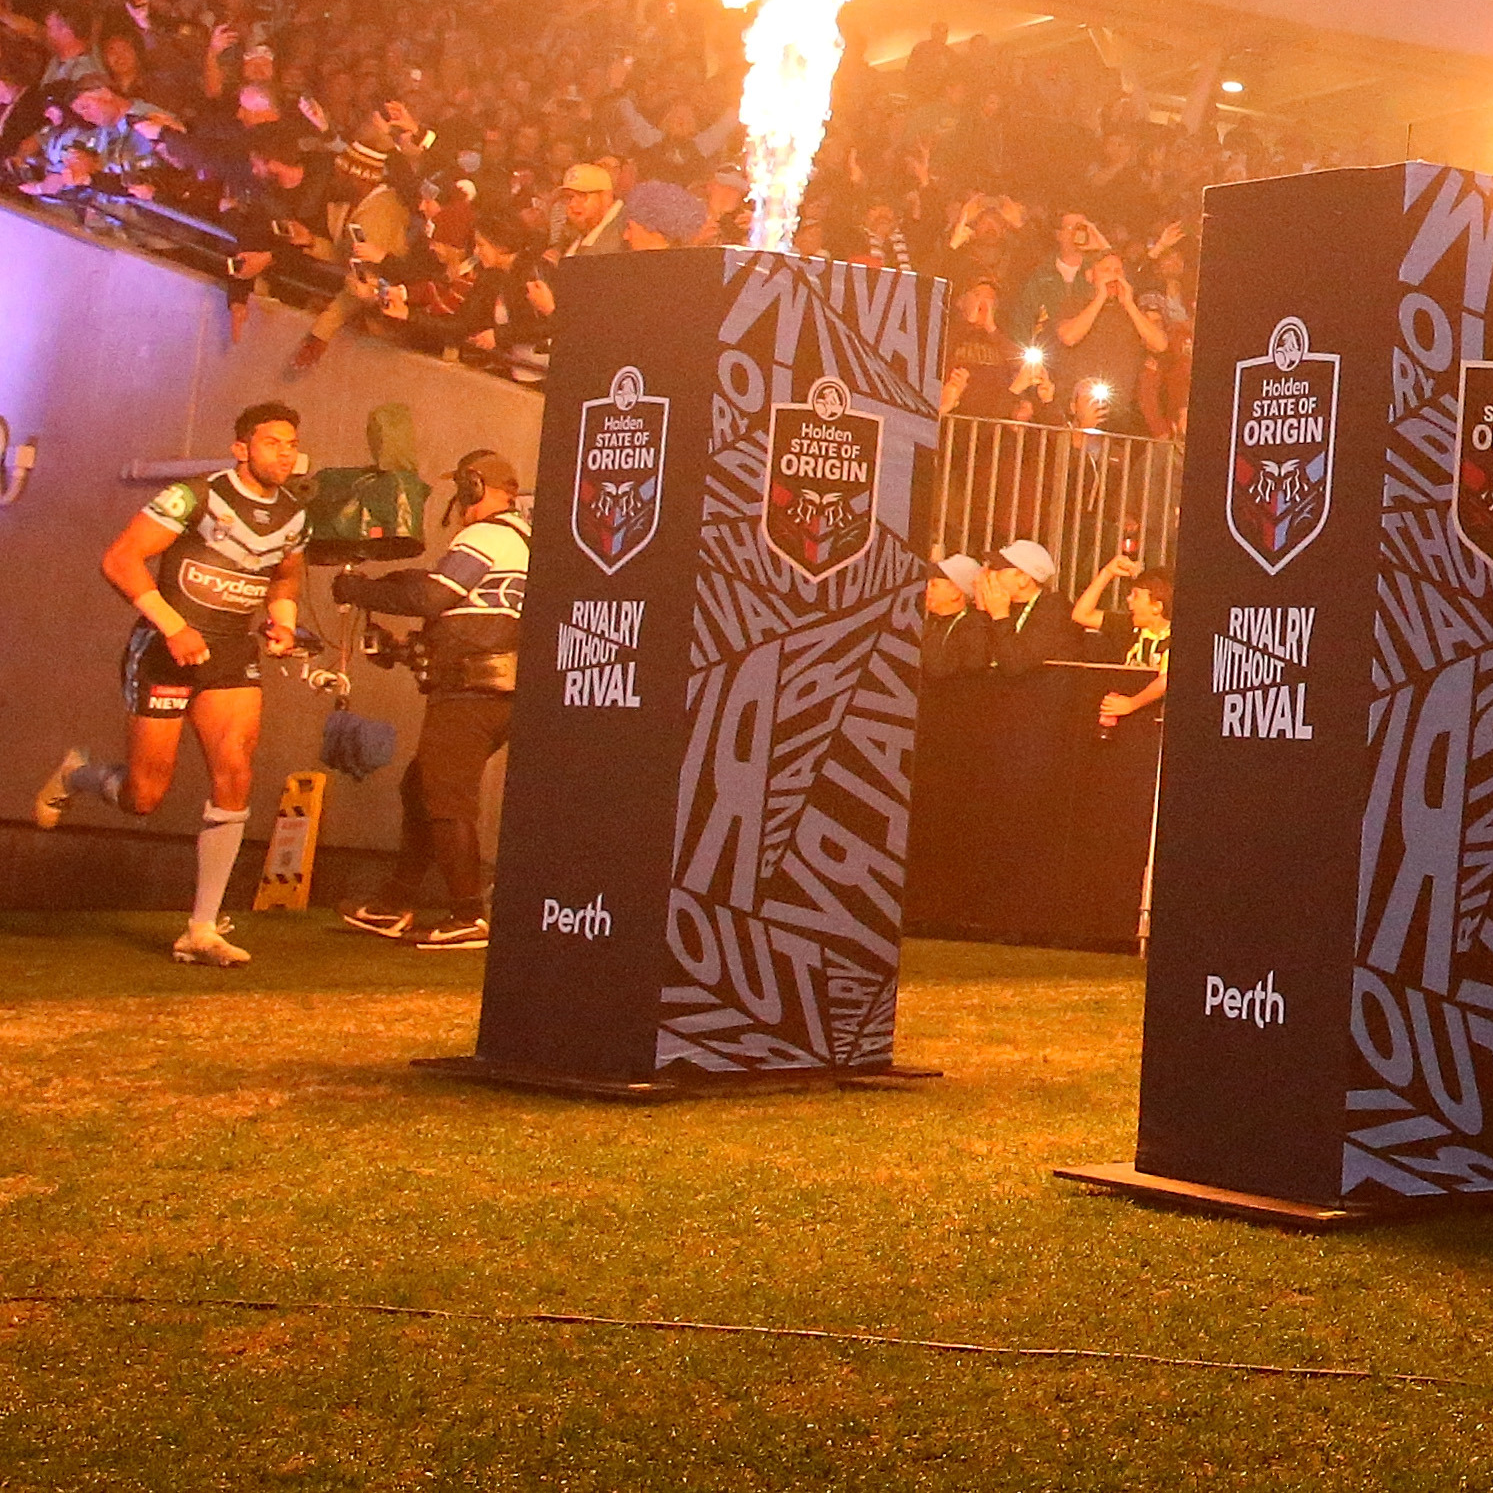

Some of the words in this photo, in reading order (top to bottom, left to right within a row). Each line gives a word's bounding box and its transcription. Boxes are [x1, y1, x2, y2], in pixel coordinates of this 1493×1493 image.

[1262, 377, 1309, 397] Holden
[1252, 398, 1296, 418] STATE
[1298, 396, 1317, 414] OF
[604, 416, 643, 430] Holden
[801, 422, 852, 442] Holden
[1243, 417, 1323, 446] ORIGIN
[596, 433, 632, 447] STATE
[634, 431, 650, 446] OF
[791, 438, 838, 457] STATE
[841, 445, 860, 459] OF
[587, 448, 655, 470] ORIGIN
[780, 453, 867, 482] ORIGIN
[572, 600, 645, 649] RIVALRY
[1229, 607, 1315, 667] RIVALRY
[557, 622, 619, 671] WITHOUT
[1212, 633, 1285, 693] WITHOUT
[564, 661, 640, 707] RIVAL
[1222, 682, 1313, 739] RIVAL
[542, 893, 611, 940] Perth
[1205, 969, 1284, 1029] Perth
